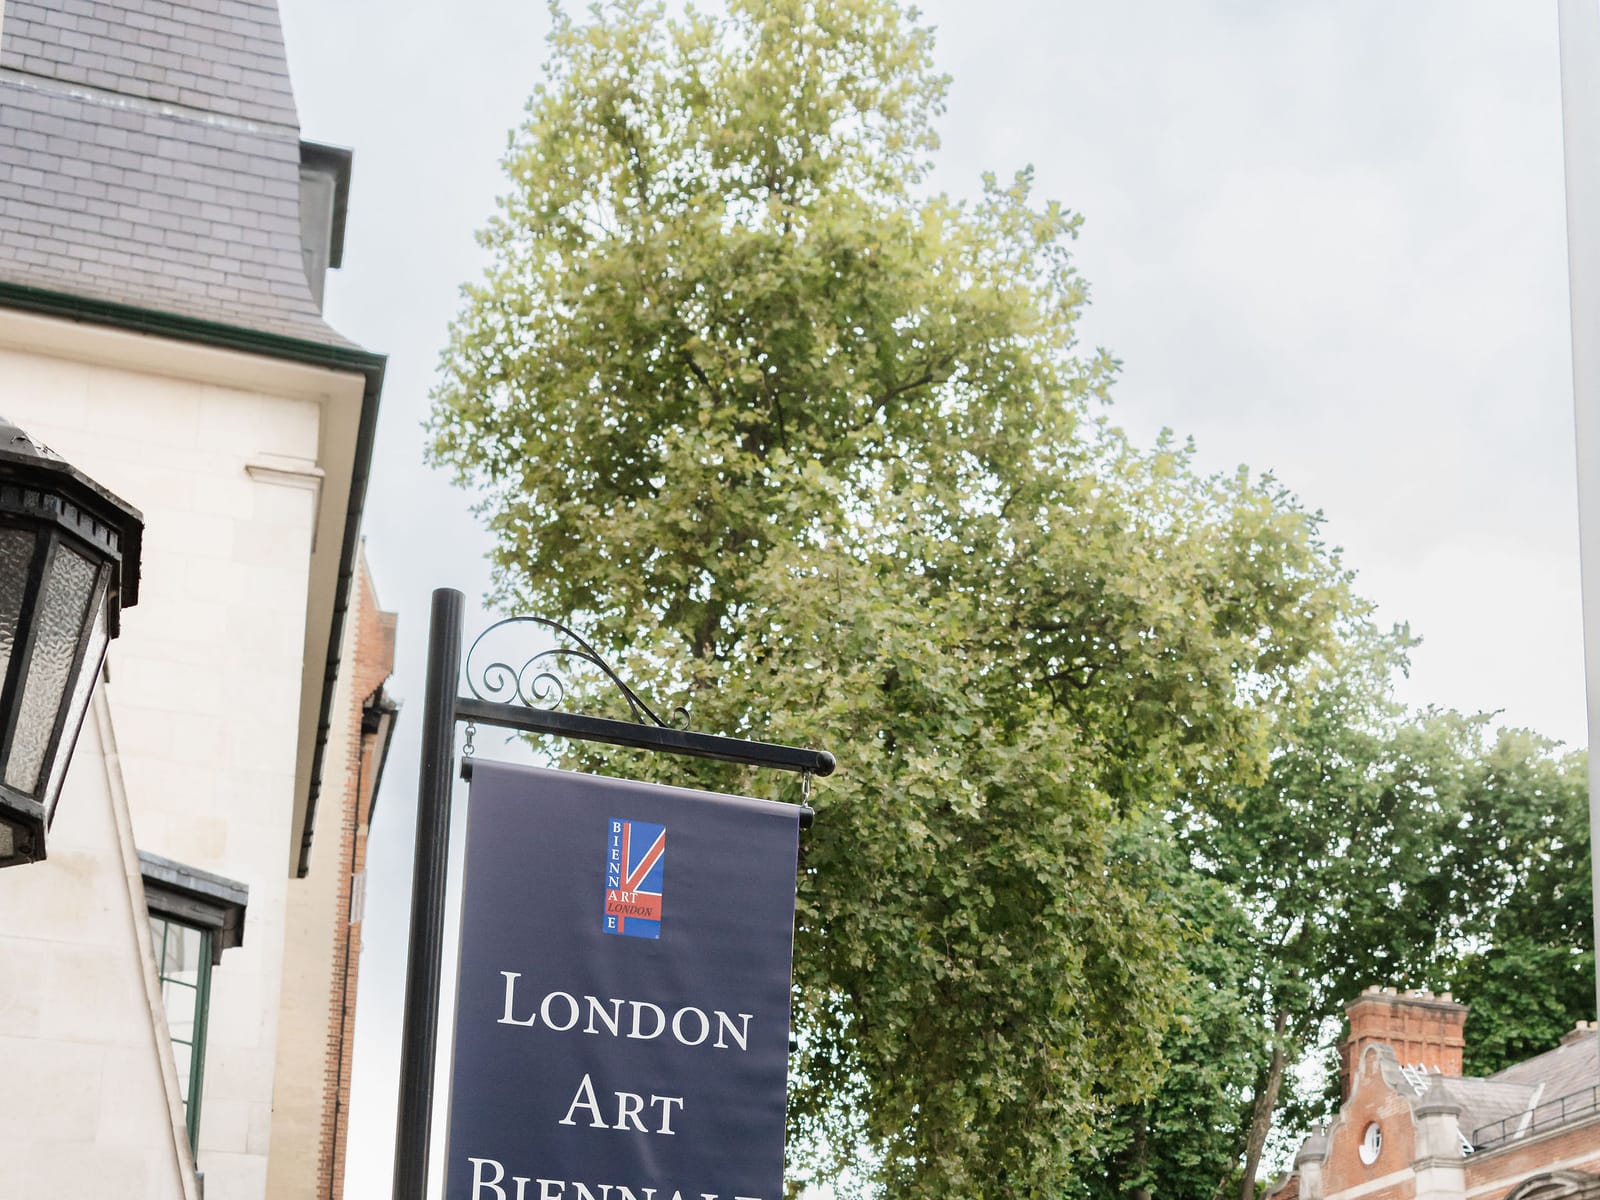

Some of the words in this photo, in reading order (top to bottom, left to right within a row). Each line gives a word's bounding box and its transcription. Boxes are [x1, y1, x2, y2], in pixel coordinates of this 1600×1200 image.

[607, 902, 653, 917] LONDON
[608, 891, 638, 903] ART
[497, 971, 753, 1051] LONDON
[559, 1074, 683, 1136] ART
